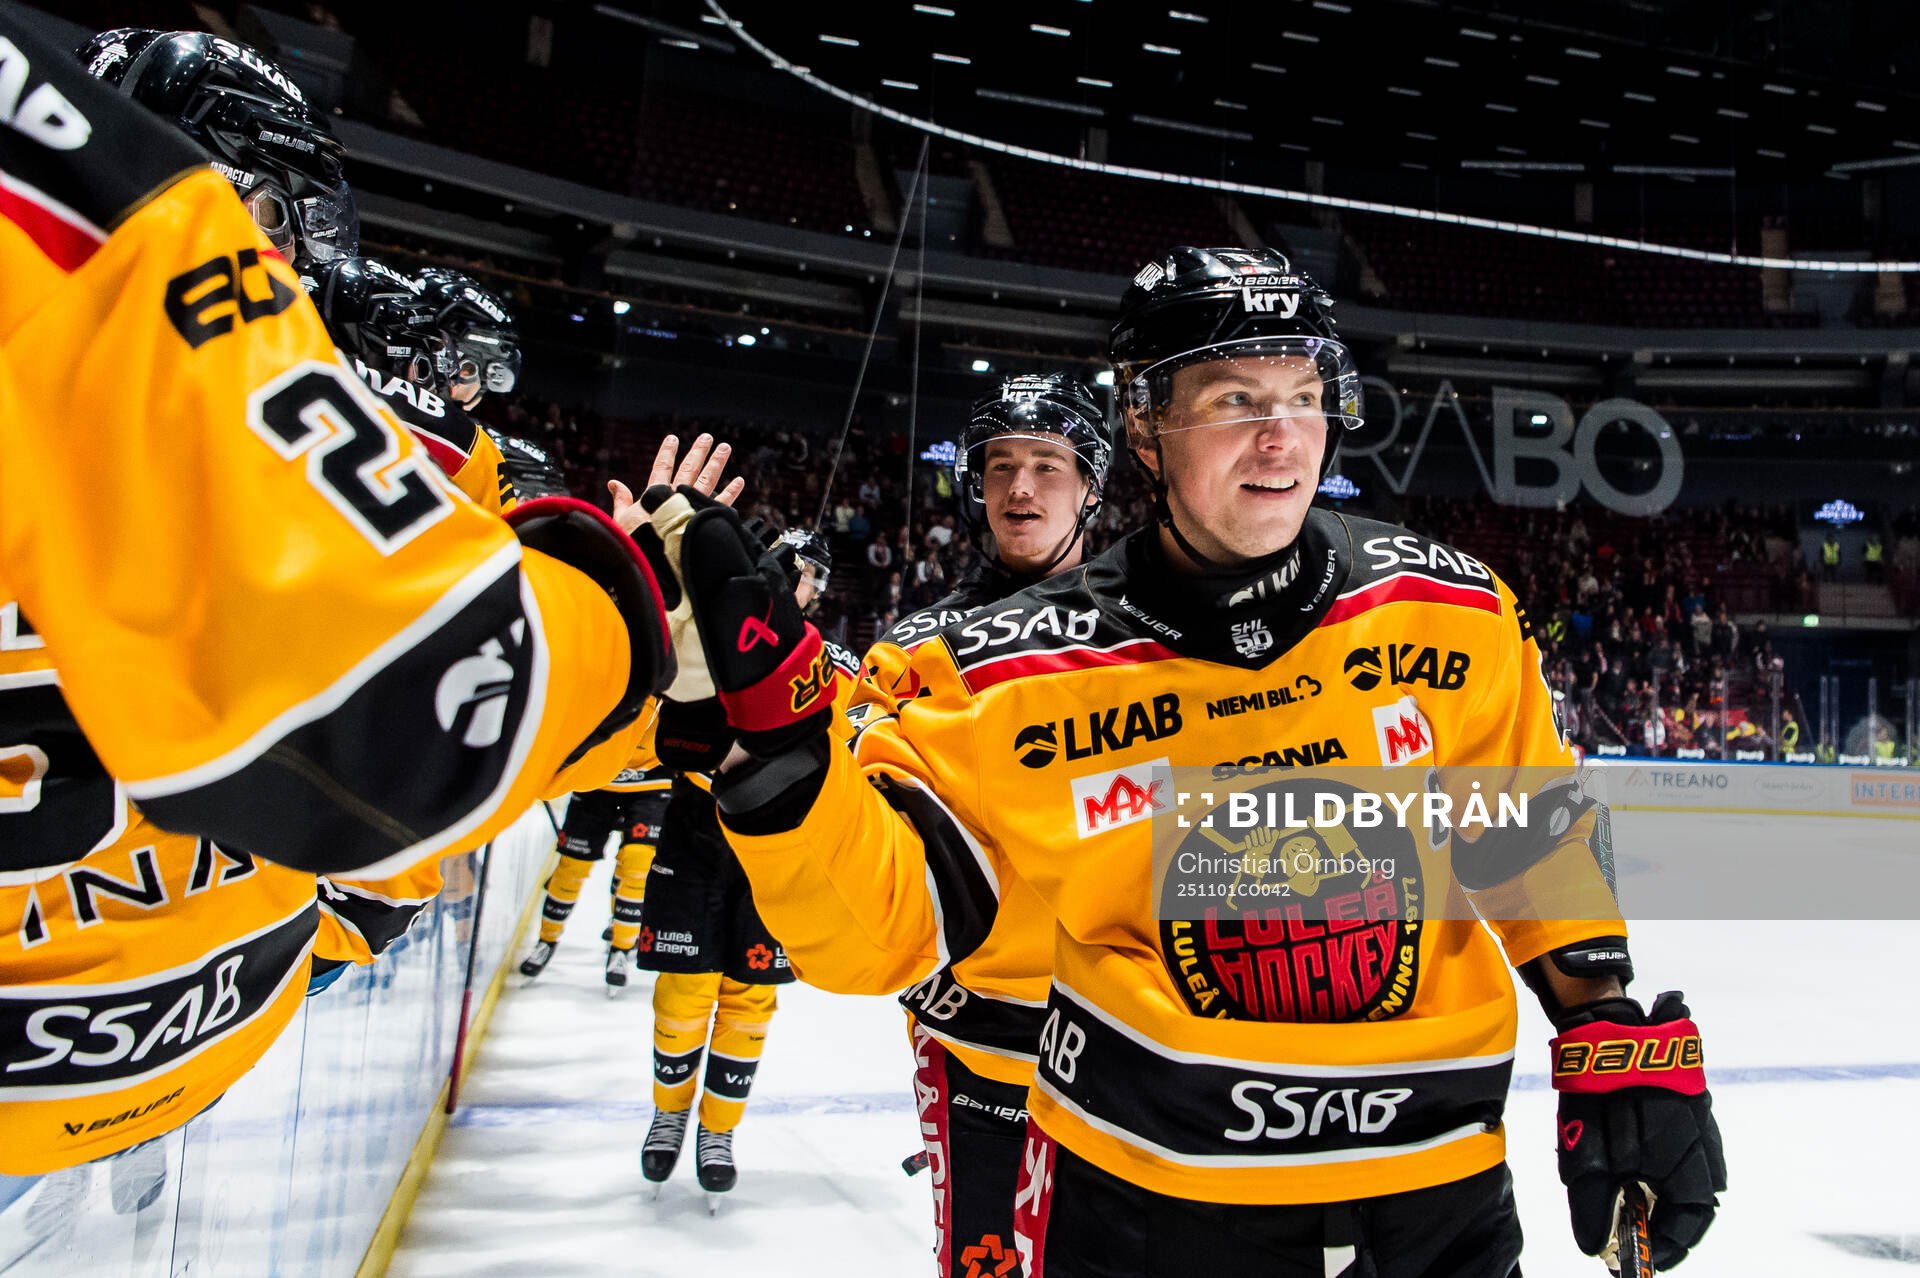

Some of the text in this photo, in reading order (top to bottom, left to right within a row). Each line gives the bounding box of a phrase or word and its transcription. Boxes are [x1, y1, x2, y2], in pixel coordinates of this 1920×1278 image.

[242, 55, 303, 102] LKAB
[1242, 286, 1300, 319] kry
[1257, 549, 1301, 601] LKA
[1362, 535, 1490, 581] SSAB
[957, 605, 1101, 656] SSAB
[1231, 618, 1268, 635] SHL
[1063, 693, 1183, 762] LKAB
[1206, 692, 1266, 720] NIEMI
[1212, 738, 1348, 782] SCANIA
[1650, 771, 1729, 790] TREANO
[1083, 774, 1165, 832] MAX
[18, 836, 260, 950] INA
[1204, 869, 1398, 950] LULEÅ
[655, 941, 699, 957] Energi
[657, 929, 693, 943] Luleå
[1171, 920, 1221, 1012] LULEÅ
[1209, 920, 1398, 1023] HOCKEY
[1367, 944, 1415, 1021] ENING
[7, 954, 245, 1073] SSAB
[904, 973, 968, 1021] AB
[1554, 1035, 1703, 1077] BAUE
[1223, 1079, 1414, 1142] SSAB
